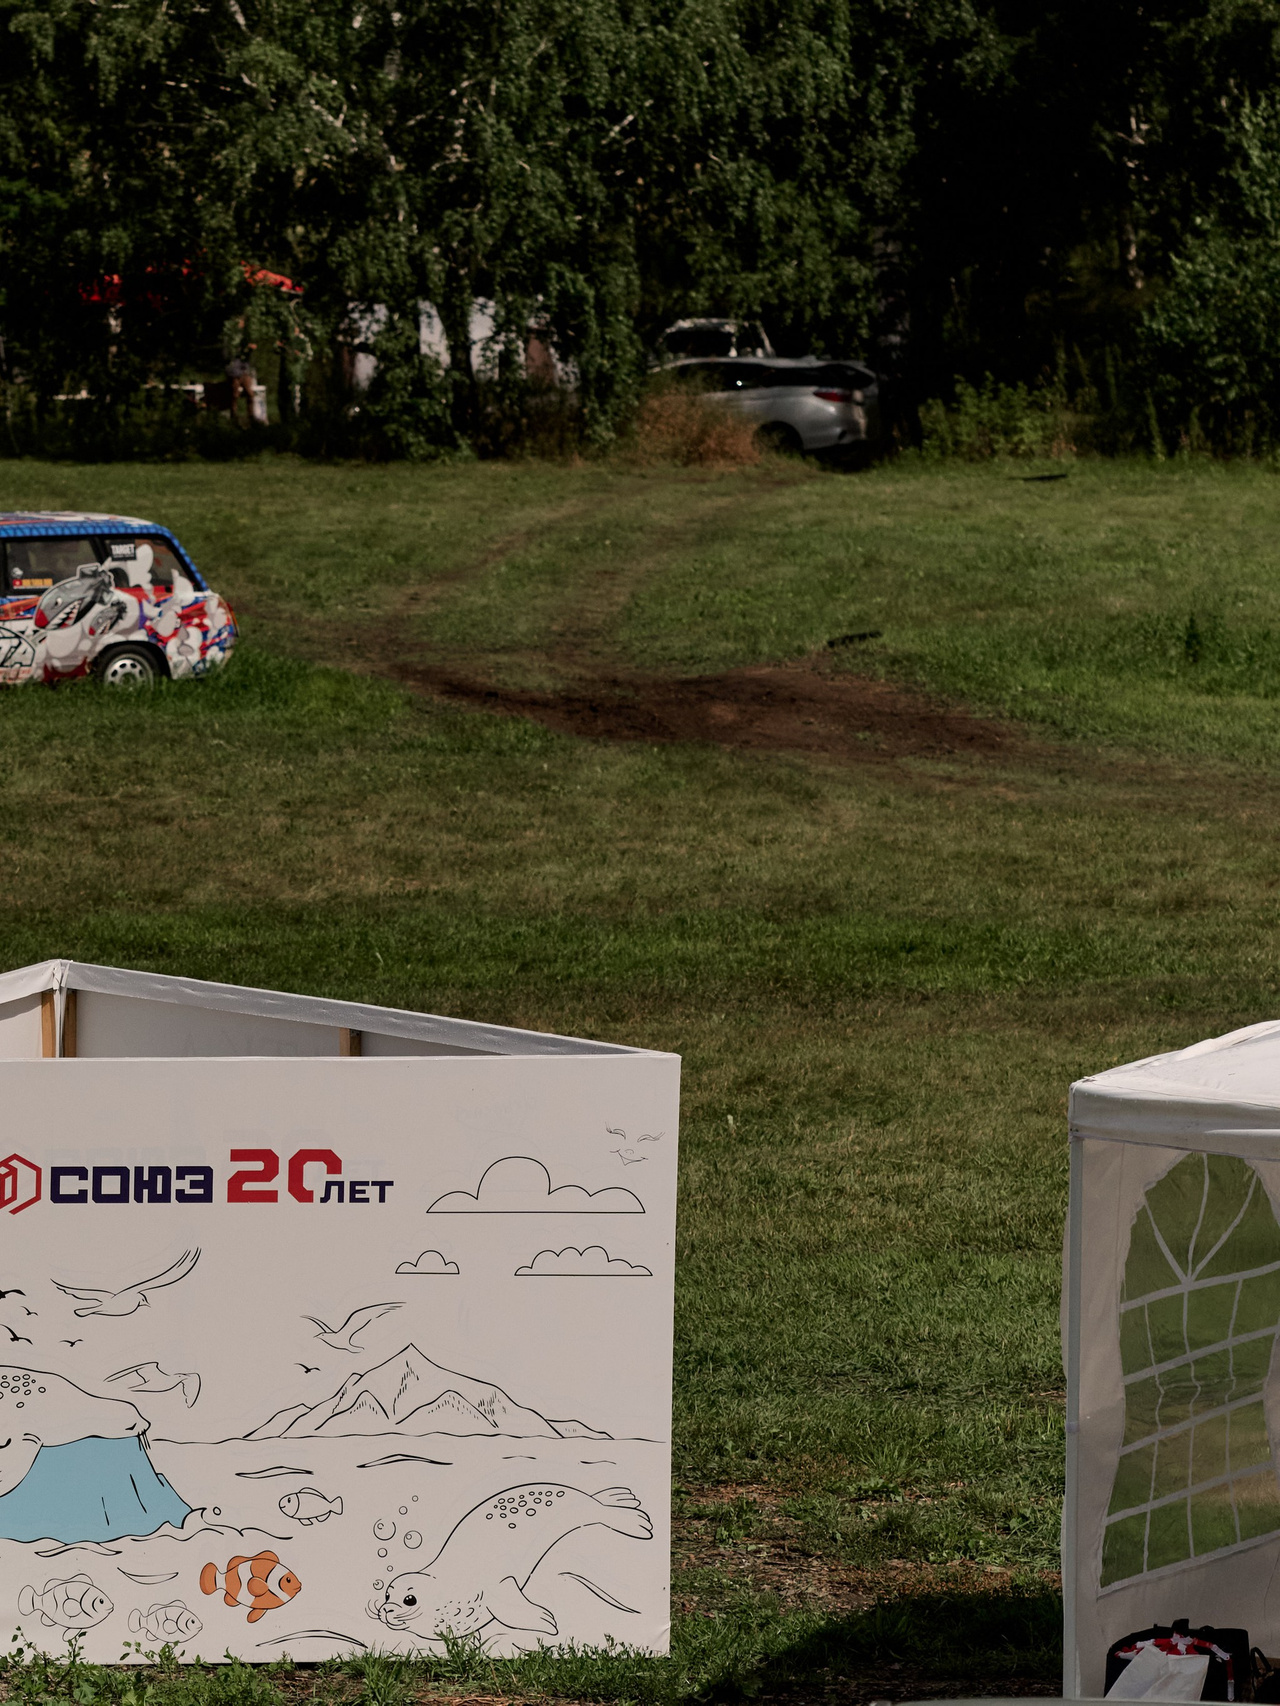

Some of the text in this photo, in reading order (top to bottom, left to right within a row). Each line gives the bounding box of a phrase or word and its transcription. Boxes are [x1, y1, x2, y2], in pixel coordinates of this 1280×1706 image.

[50, 1149, 395, 1204] СОЮЗ 20 ЛЕТ
